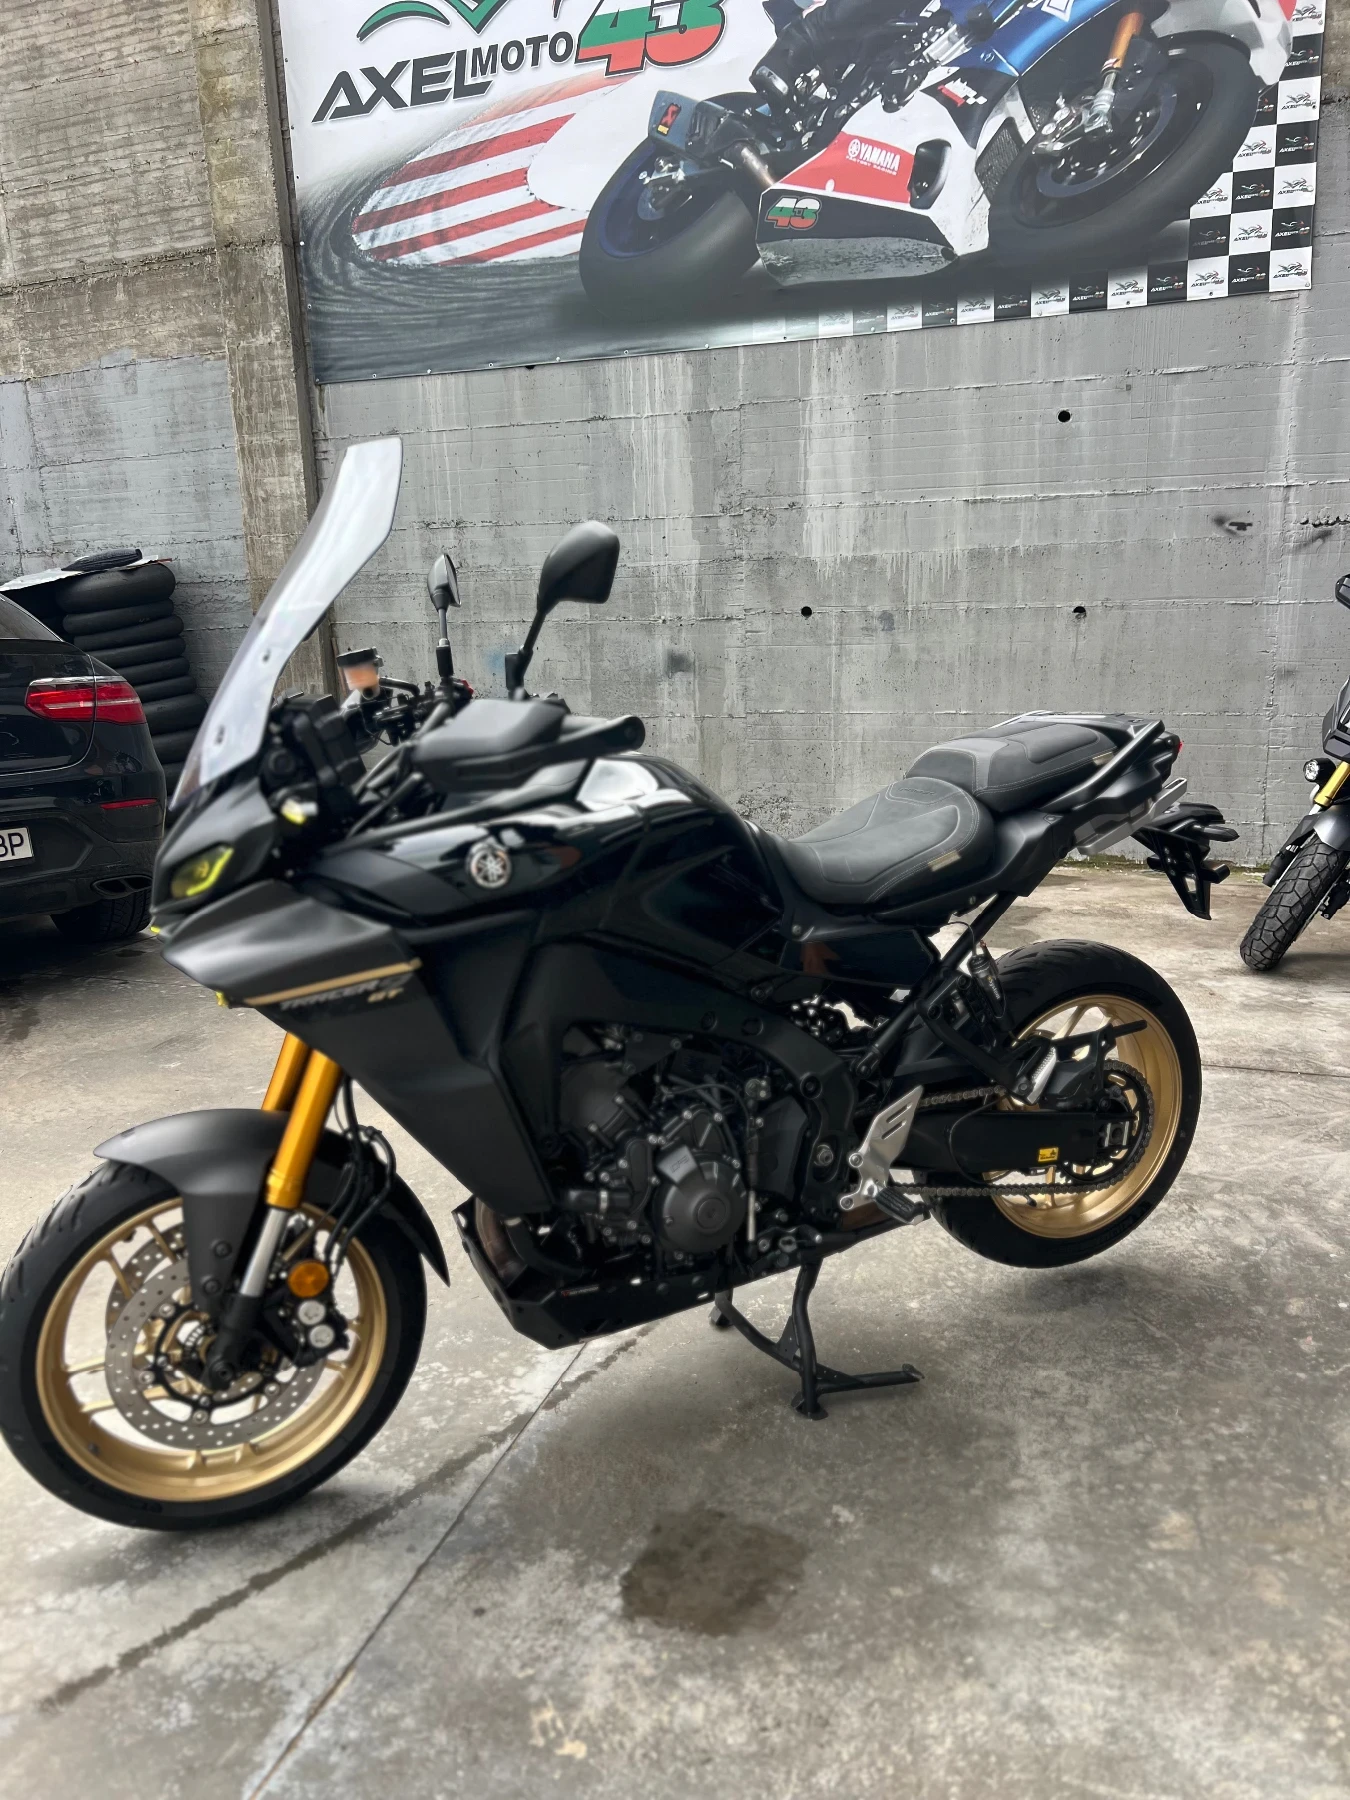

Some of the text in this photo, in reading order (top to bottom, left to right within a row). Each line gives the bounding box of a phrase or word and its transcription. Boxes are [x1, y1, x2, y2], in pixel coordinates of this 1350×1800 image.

[575, 0, 726, 75] 43
[860, 142, 900, 171] YAMAHA
[765, 195, 822, 230] 43
